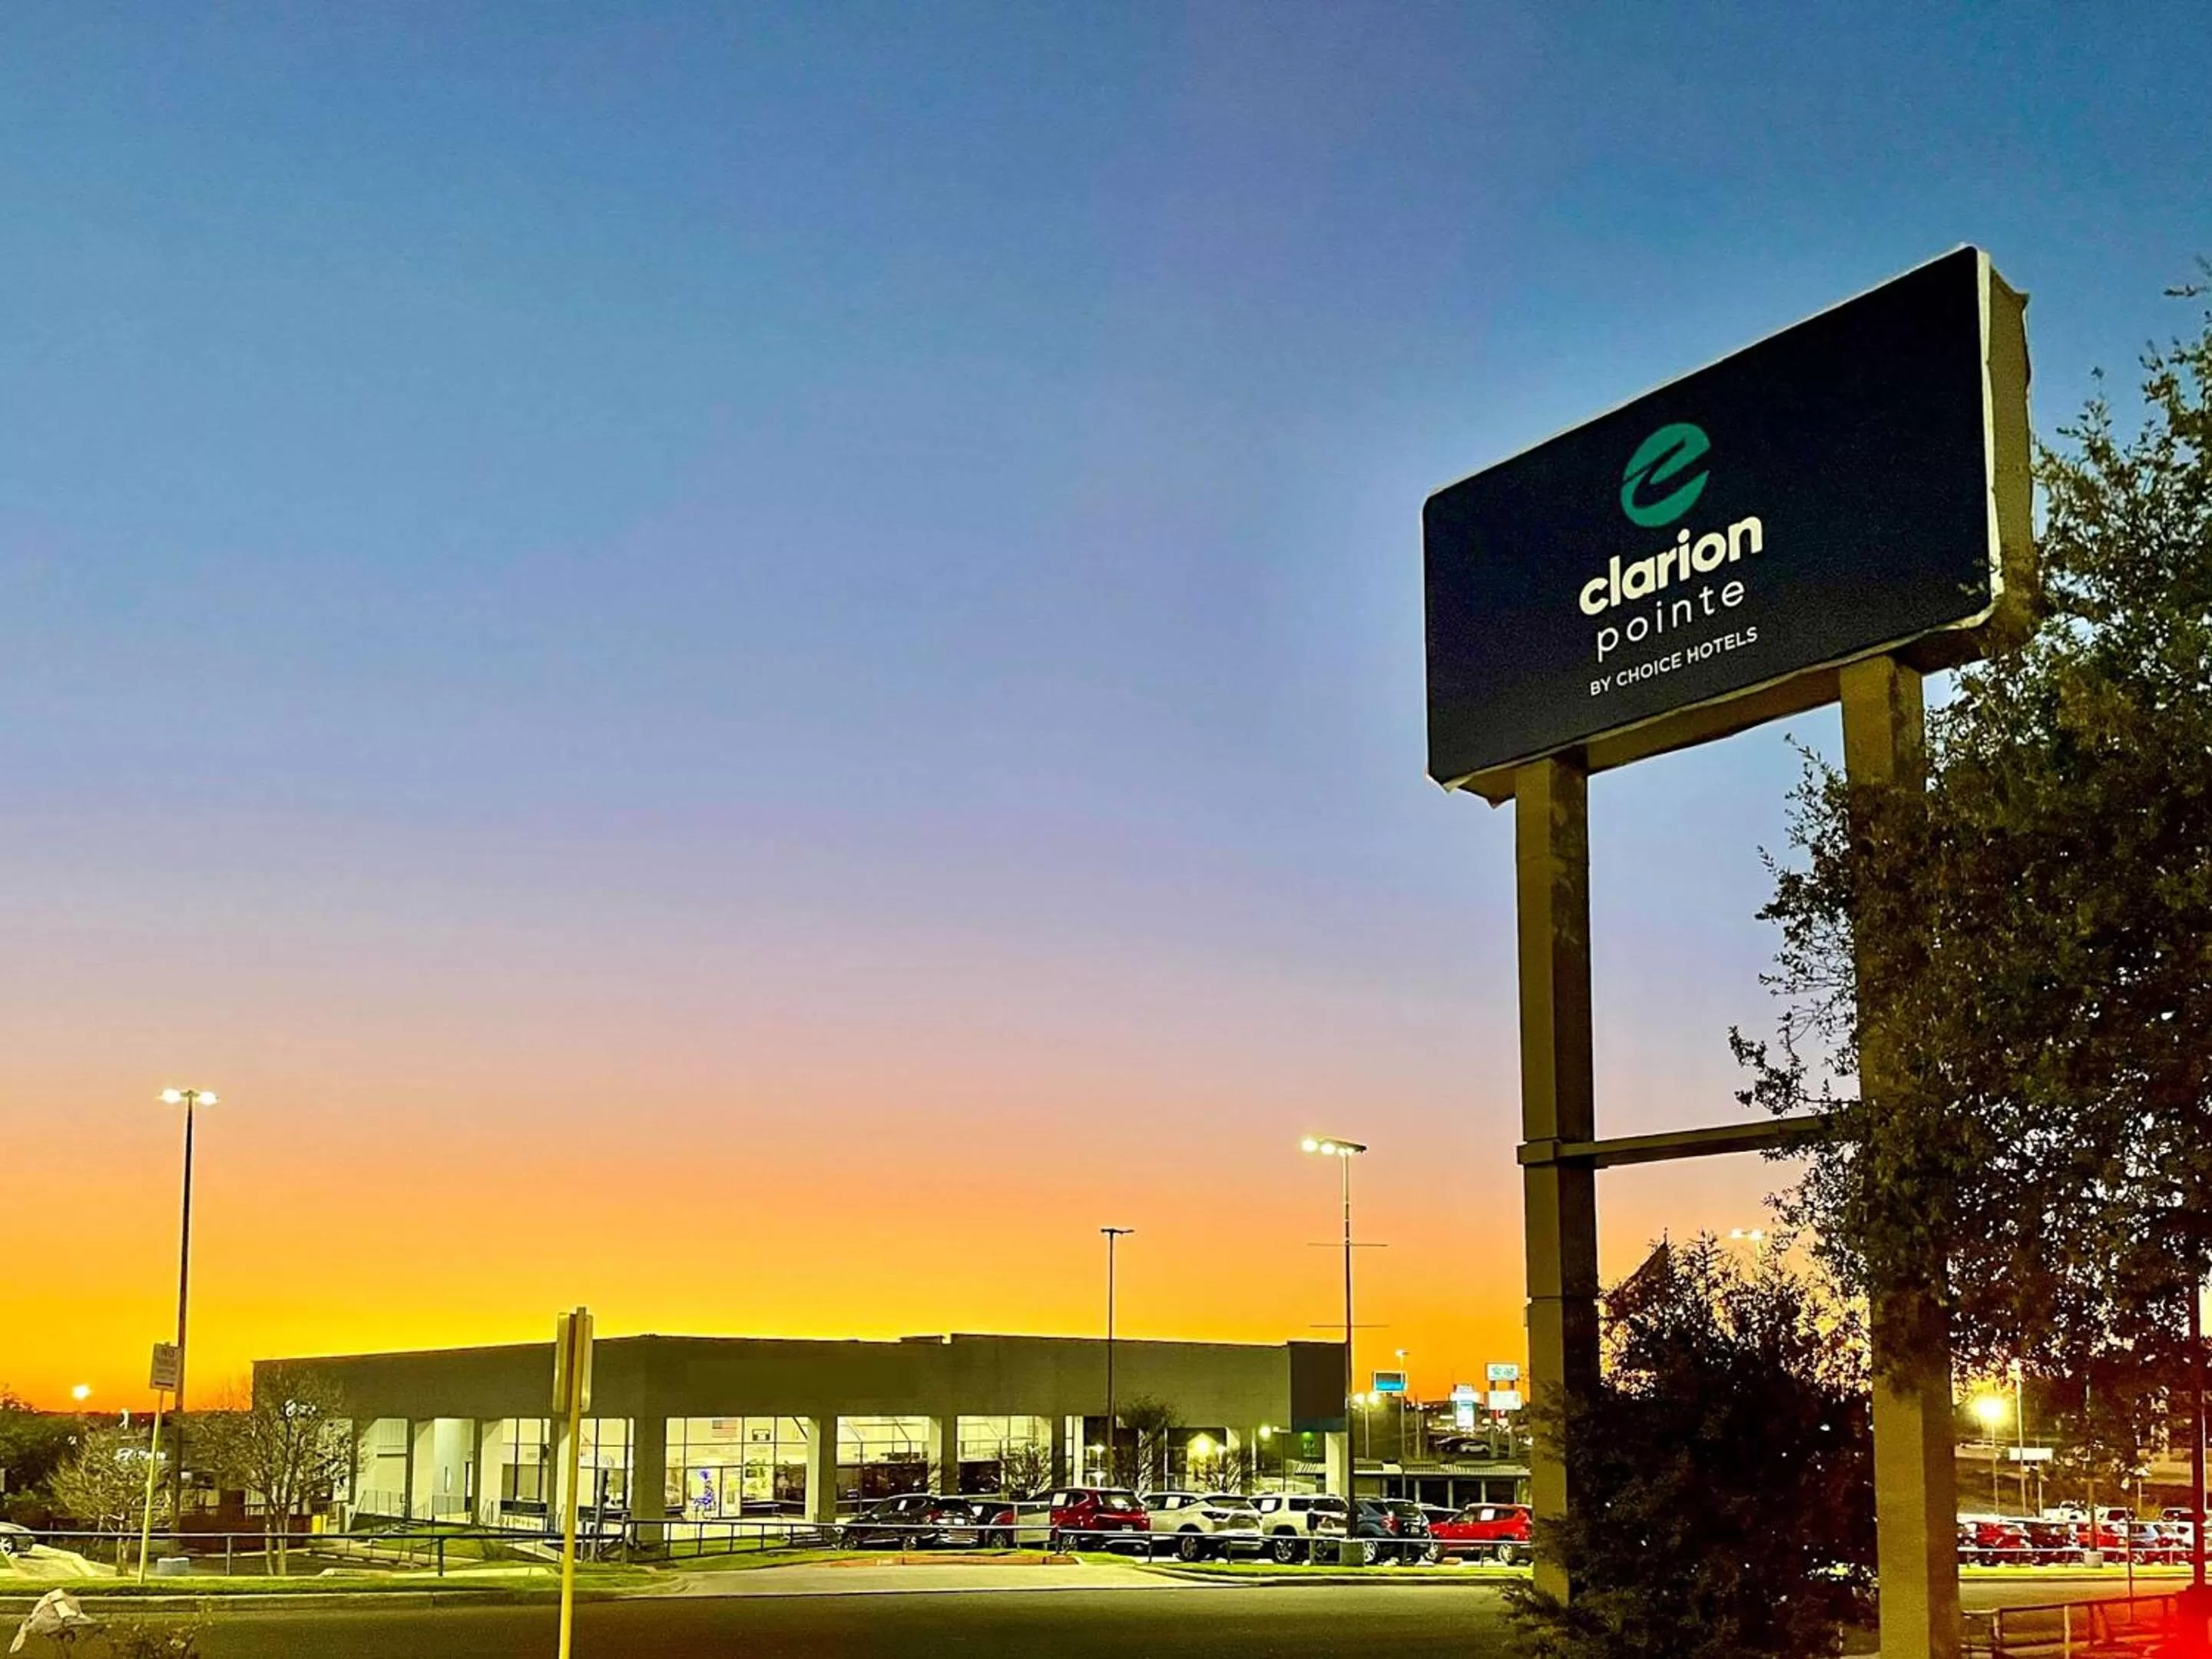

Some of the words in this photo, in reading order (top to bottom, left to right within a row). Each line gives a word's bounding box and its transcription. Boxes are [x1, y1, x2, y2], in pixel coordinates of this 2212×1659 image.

[1579, 516, 1763, 615] clarion
[1590, 676, 1611, 695] BY
[1616, 652, 1682, 687] CHOICE
[1687, 627, 1758, 664] HOTELS
[1598, 581, 1745, 662] pointe
